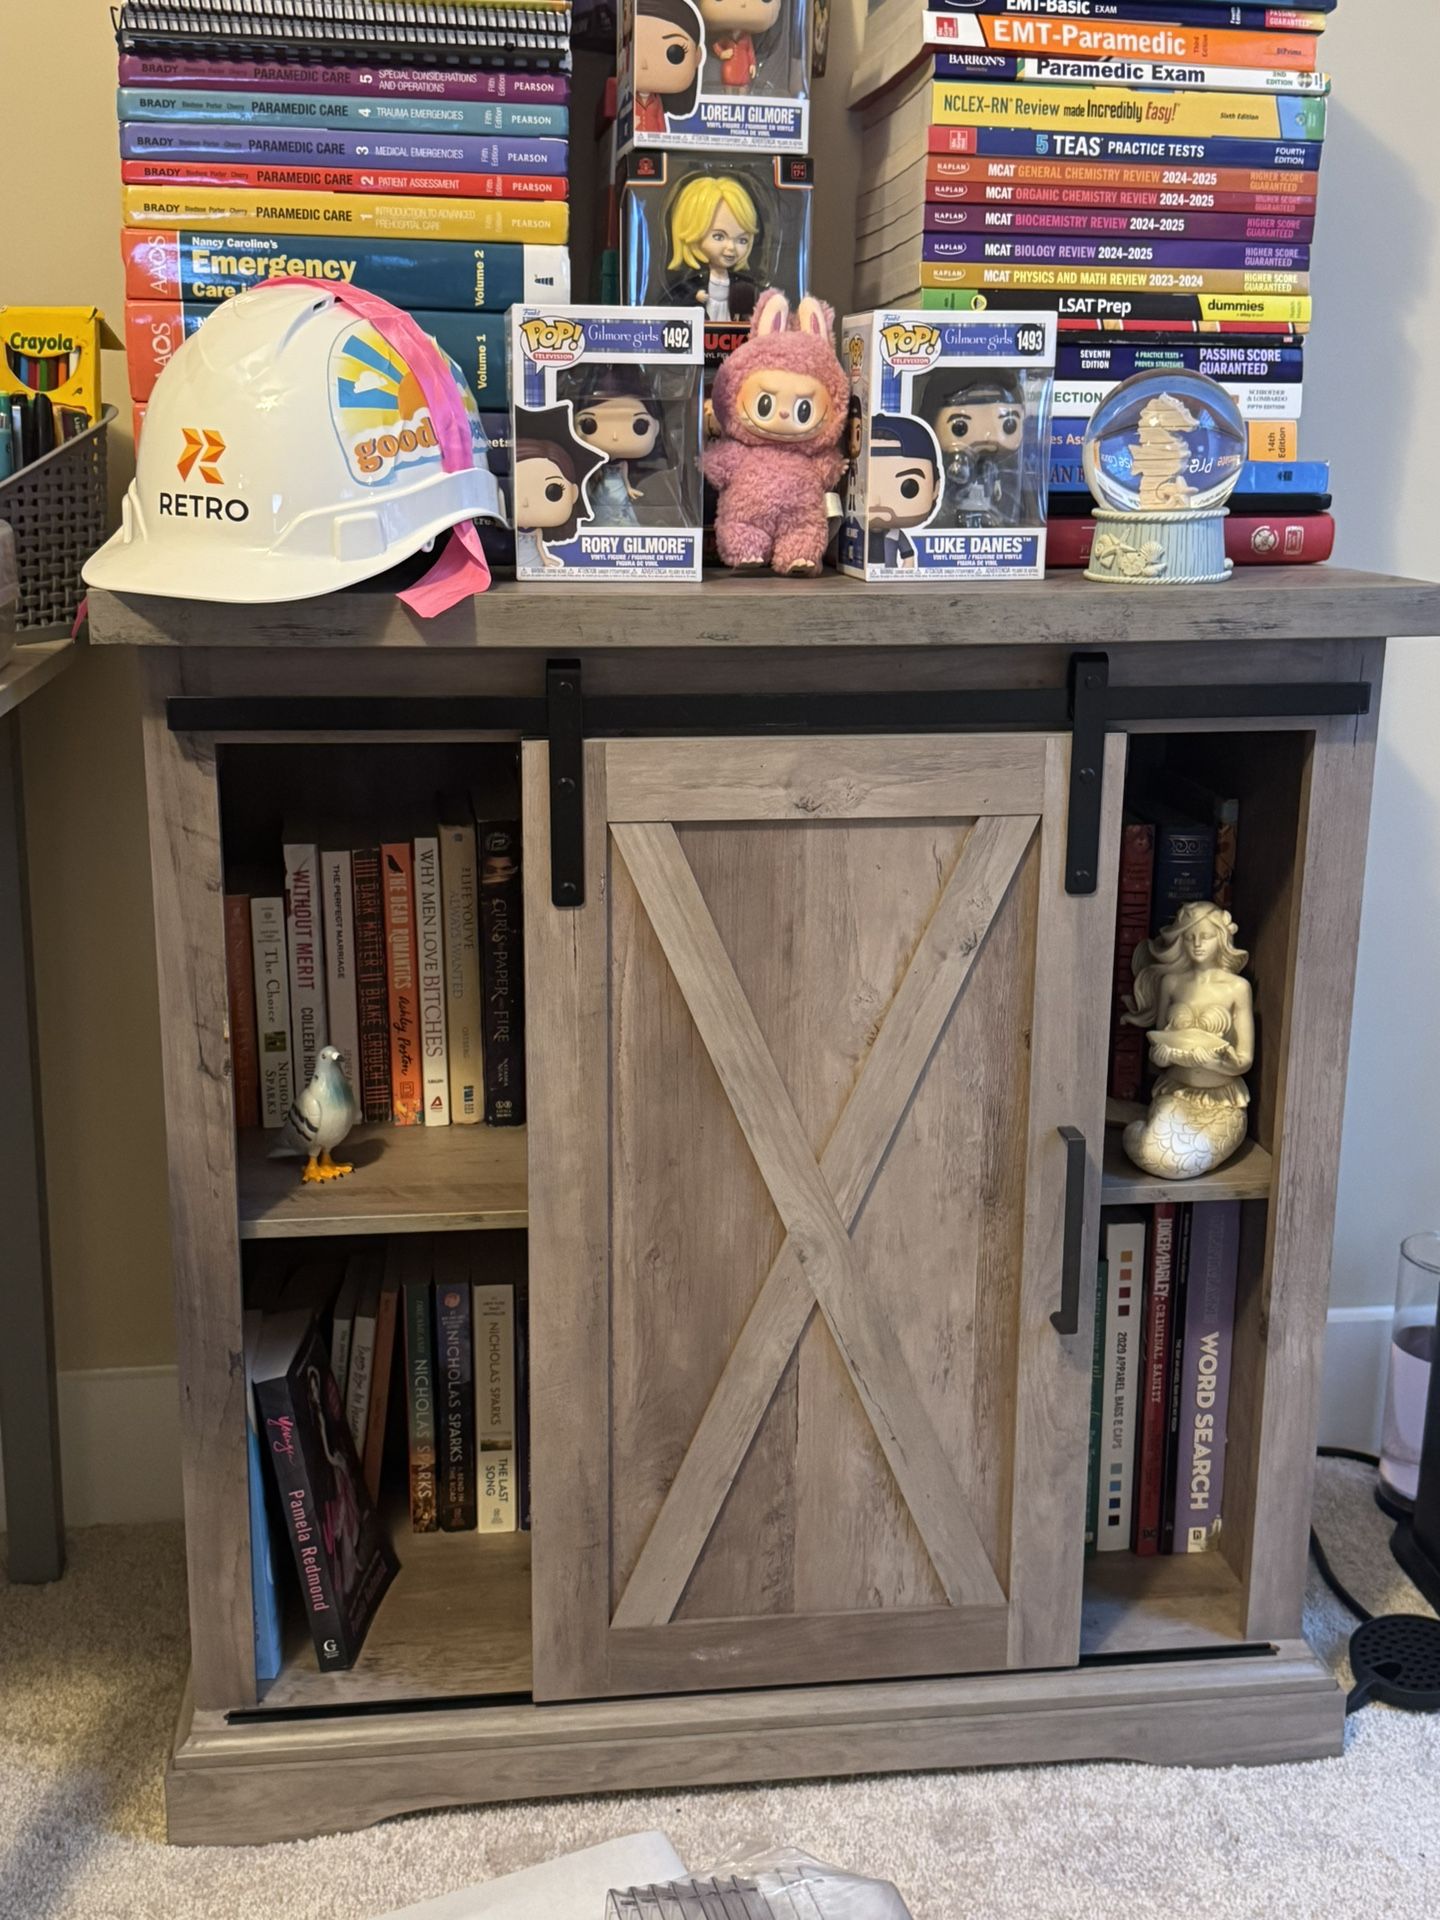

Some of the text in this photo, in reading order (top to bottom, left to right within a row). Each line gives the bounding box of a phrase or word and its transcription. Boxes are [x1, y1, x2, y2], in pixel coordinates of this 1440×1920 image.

[1095, 5, 1117, 14] EXAM
[993, 19, 1187, 56] EMT-Paramedic
[949, 54, 1006, 67] BARRON'S
[1036, 58, 1206, 83] Paramedic Exam
[142, 63, 179, 74] BRADY
[253, 68, 321, 82] PARAMEDIC
[322, 71, 351, 83] CARE
[360, 70, 477, 84] 5 SPECIAL CONSIDERATIONS
[379, 81, 445, 93] AND OPERATIONS
[513, 81, 555, 92] PEARSON
[139, 98, 177, 109] BRADY
[251, 101, 317, 116] PARAMEDIC
[319, 103, 349, 117] CARE
[358, 107, 464, 121] 4 TRAUMA EMERGENCIES
[700, 104, 745, 122] LORELAI
[1015, 99, 1060, 116] Review
[1063, 104, 1085, 117] made
[1086, 99, 1143, 123] Incredibly
[1145, 101, 1177, 124] Easy!
[1219, 112, 1259, 121] Sixth Edition
[511, 114, 552, 125] PEARSON
[136, 136, 174, 147] BRADY
[248, 139, 314, 153] PARAMEDIC
[316, 142, 345, 155] CARE
[356, 145, 464, 160] 3 MEDICAL EMERGENCIES
[1035, 134, 1205, 158] 5 TEAS PRACTICE TESTS
[1275, 147, 1306, 156] FOURTH
[507, 153, 548, 163] PEARSON
[1274, 156, 1305, 165] EDITION
[144, 167, 181, 177] BRADY
[256, 170, 322, 184] PARAMEDIC
[324, 173, 353, 185] CARE
[360, 175, 460, 190] 2 PATIENT ASSESSMENT
[988, 164, 1015, 177] MCAT
[1018, 165, 1062, 178] GENERAL
[1065, 167, 1119, 182] CHEMISTRY
[1123, 170, 1160, 183] REVIEW
[512, 182, 553, 193] PEARSON
[986, 187, 1013, 199] MCAT
[1016, 188, 1060, 201] ORGANIC
[1062, 190, 1117, 203] CHEMISTRY
[1120, 192, 1157, 204] REVIEW
[1250, 182, 1298, 192] GUARANTEED
[143, 203, 352, 222] BRADY PARAMEDIC CARE
[985, 213, 1012, 225] MCAT
[1015, 214, 1088, 228] BIOCHEMISTRY
[1090, 216, 1128, 230] REVIEW
[511, 218, 552, 229] PEARSON
[1246, 228, 1294, 238] GUARANTEED
[1247, 218, 1300, 228] HIGHER SCORE
[192, 237, 278, 249] Nancy Caroline's
[985, 243, 1012, 256] MCAT
[1014, 244, 1056, 258] BIOLOGY
[1058, 245, 1096, 258] REVIEW
[1245, 247, 1299, 257] HIGHER SCORE
[148, 235, 168, 294] AAOS
[191, 249, 357, 284] Emergency
[1245, 257, 1293, 267] GUARANTEED
[474, 260, 485, 306] Volume
[984, 269, 1010, 283] MCAT
[1013, 270, 1055, 284] PHYSICS
[1056, 272, 1078, 284] AND
[1080, 272, 1107, 285] MATH
[1109, 273, 1147, 286] REVIEW
[1244, 273, 1298, 283] HIGHER SCORE
[1244, 282, 1292, 292] GUARANTEED
[191, 281, 236, 297] Care
[1058, 297, 1132, 317] LSAT Prep
[1207, 298, 1265, 312] dummies
[10, 332, 74, 354] Crayola
[520, 319, 585, 351] POP!
[588, 325, 660, 348] Gilmore girls
[662, 327, 690, 349] 1492
[880, 325, 941, 357] POP!
[945, 328, 1013, 351] Gilmore girls
[1016, 330, 1043, 351] 1493
[1080, 350, 1111, 359] SEVENTH
[1081, 360, 1110, 369] EDITION
[1199, 348, 1281, 361] PASSING SCORE
[477, 345, 487, 390] Volume
[1199, 363, 1268, 376] GUARANTEED
[353, 416, 438, 474] good
[1267, 432, 1276, 453] 14th
[1278, 426, 1287, 459] Edition
[159, 492, 250, 523] RETRO
[581, 537, 619, 554] RORY
[925, 537, 965, 554] LUKE
[388, 872, 407, 892] THE
[389, 896, 408, 923] DEAD
[291, 869, 316, 990] WITHOUT MERIT
[333, 884, 345, 979] PERFECT MARRIAGE
[359, 883, 380, 967] DARK MATTER
[264, 949, 279, 975] The
[420, 848, 443, 1058] WHY MEN LOVE BITCHES
[265, 978, 283, 1023] Choice
[300, 1007, 315, 1051] COLLEEN
[363, 988, 387, 1080] BLAKE CROUCH
[393, 995, 412, 1076] Ashley Poston
[1150, 1217, 1174, 1403] JOKER/HARLEY: CRIMINAL SANITY
[488, 1321, 501, 1384] NICHOLAS
[446, 1329, 462, 1408] NICHOLAS
[1194, 1331, 1220, 1409] WORD
[489, 1386, 502, 1425] SPARKS
[414, 1359, 433, 1498] NICHOLAS SPARKS
[1112, 1396, 1124, 1450] BAGS CAPS
[449, 1413, 463, 1463] SPARKS
[1189, 1413, 1214, 1511] SEARCH
[485, 1465, 497, 1497] SONG
[498, 1458, 509, 1503] THE LAST
[288, 1489, 330, 1612] Pamela Redmond
